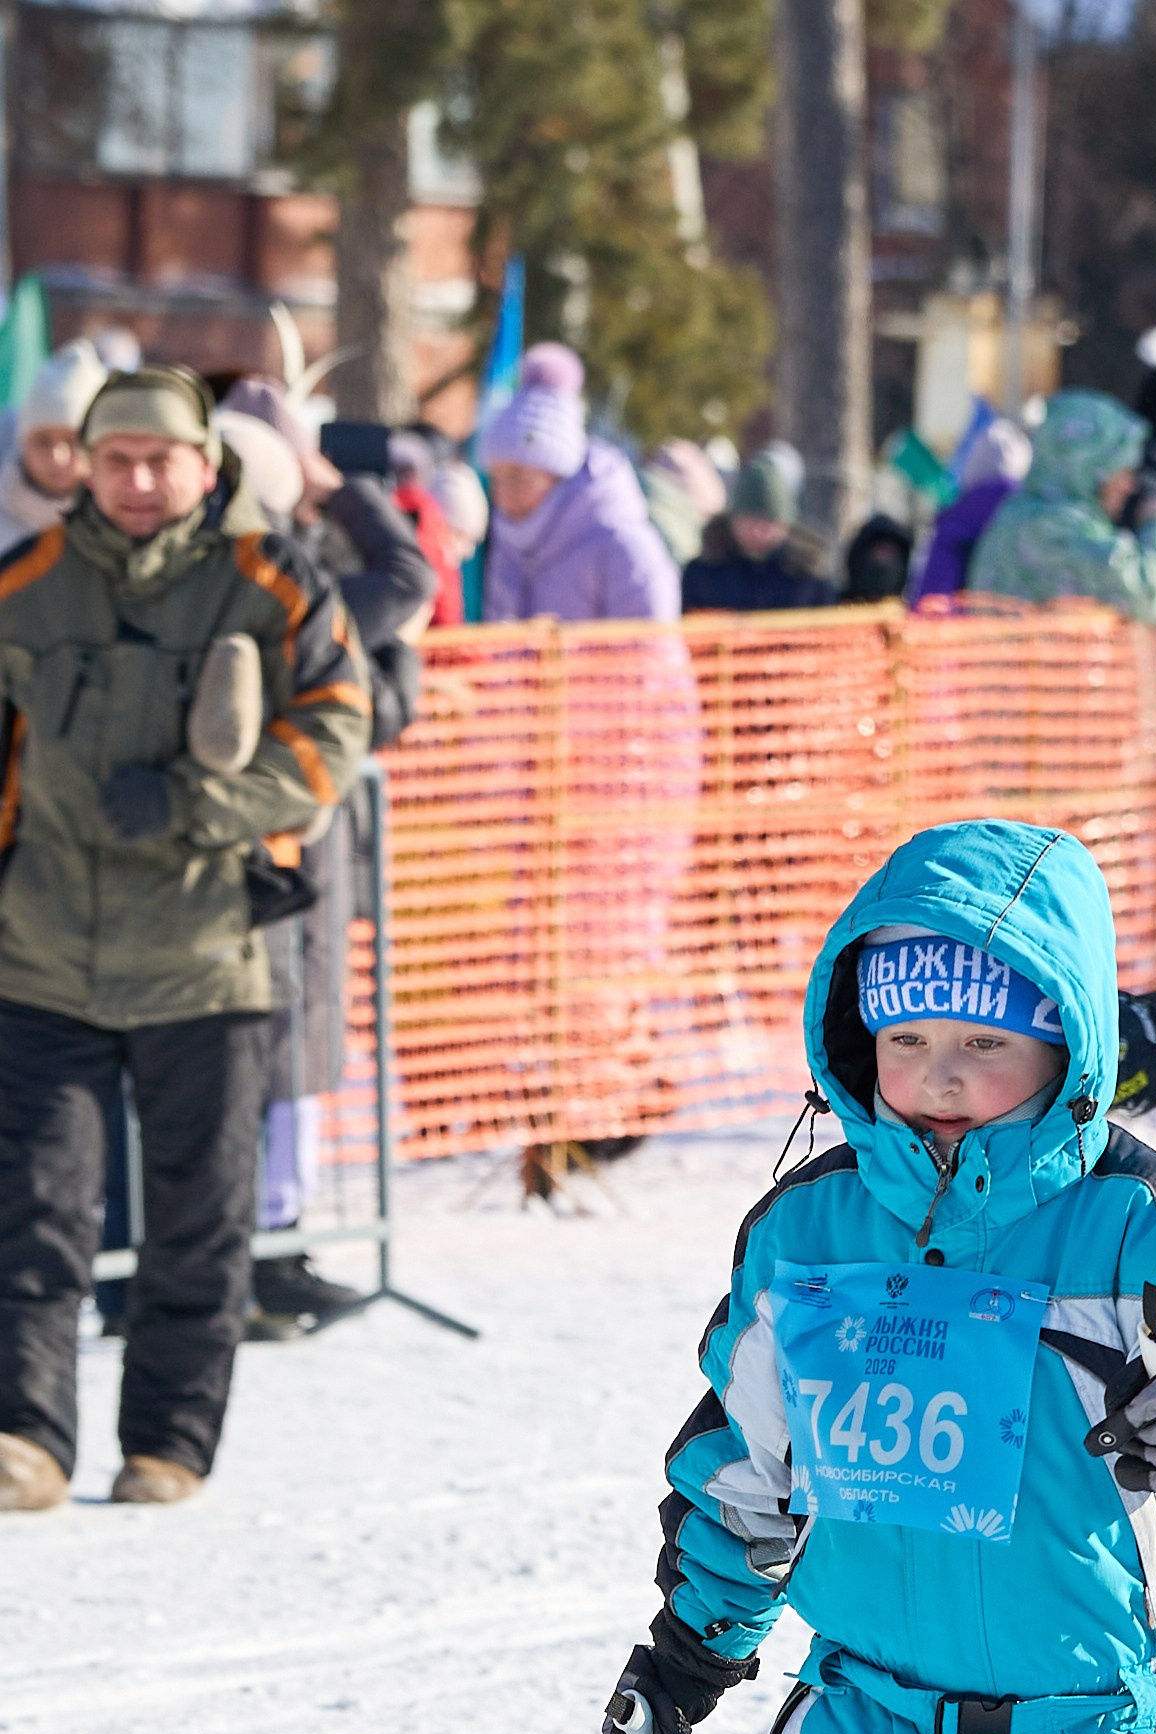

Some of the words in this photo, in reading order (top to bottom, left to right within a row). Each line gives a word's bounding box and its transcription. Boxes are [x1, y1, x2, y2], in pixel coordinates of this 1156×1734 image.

[866, 943, 1010, 987] ЛЫЖНЯ
[866, 980, 1009, 1020] РОССИИ
[870, 1315, 949, 1341] ЛЫЖНЯ
[865, 1336, 947, 1361] РОССИИ
[864, 1358, 896, 1376] 2026
[798, 1378, 968, 1474] 7436
[814, 1463, 957, 1493] НОВОСИБИРСКАЯ
[839, 1487, 901, 1504] ОБЛАСТЬ
